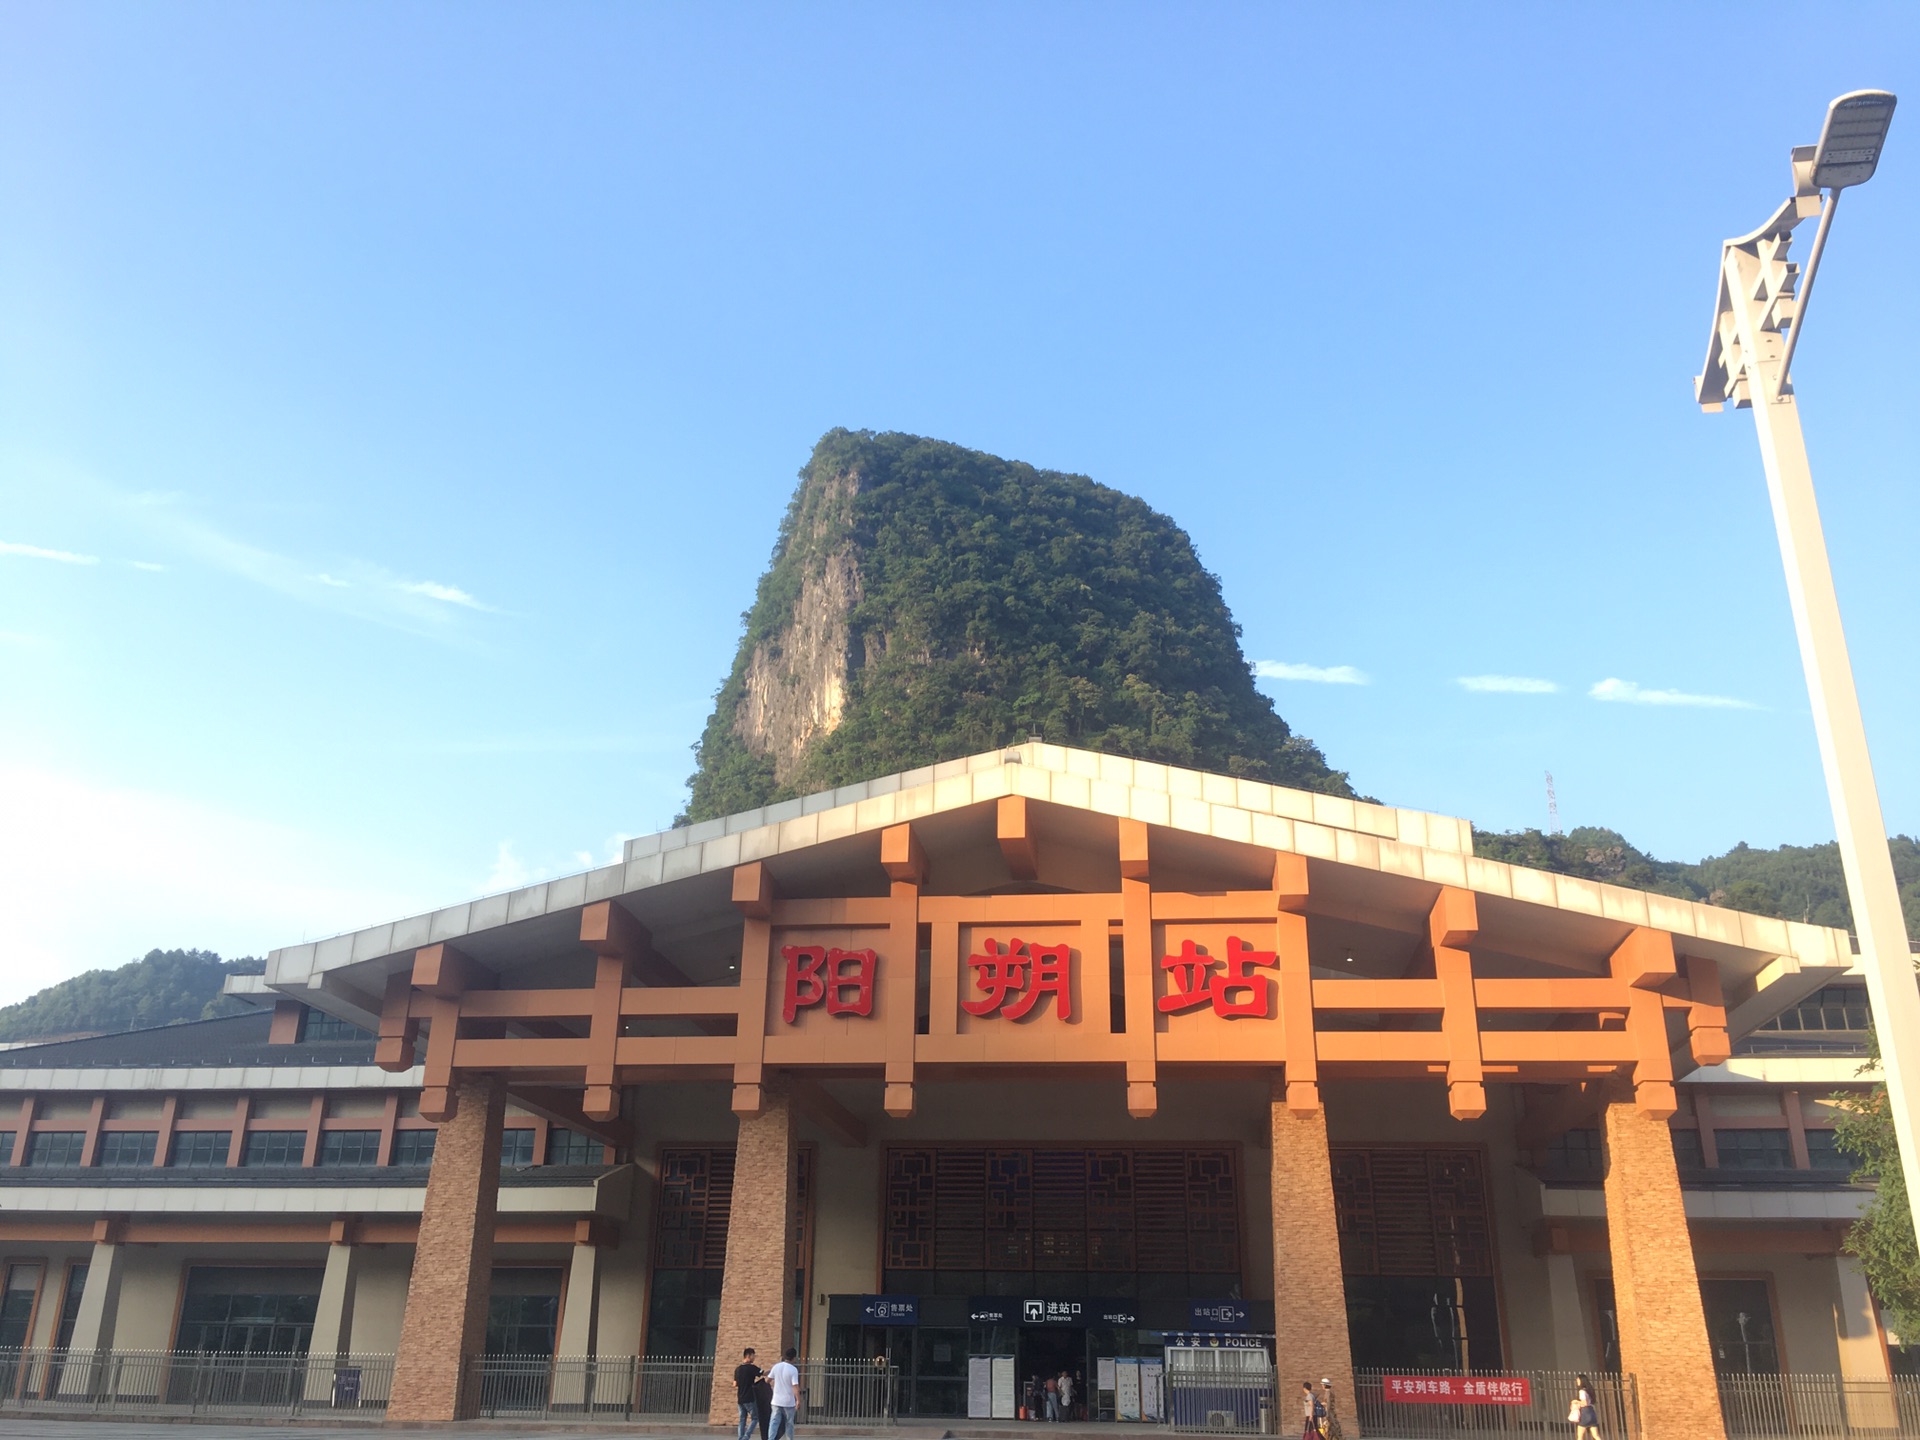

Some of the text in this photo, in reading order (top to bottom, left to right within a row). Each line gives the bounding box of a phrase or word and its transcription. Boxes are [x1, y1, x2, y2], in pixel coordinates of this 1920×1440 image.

[781, 935, 1281, 1023] 阳朔站
[891, 1304, 913, 1312] 售票处
[1047, 1302, 1081, 1314] 进站口
[1195, 1307, 1219, 1316] 出站口
[1176, 1337, 1261, 1347] 公安 POLICE
